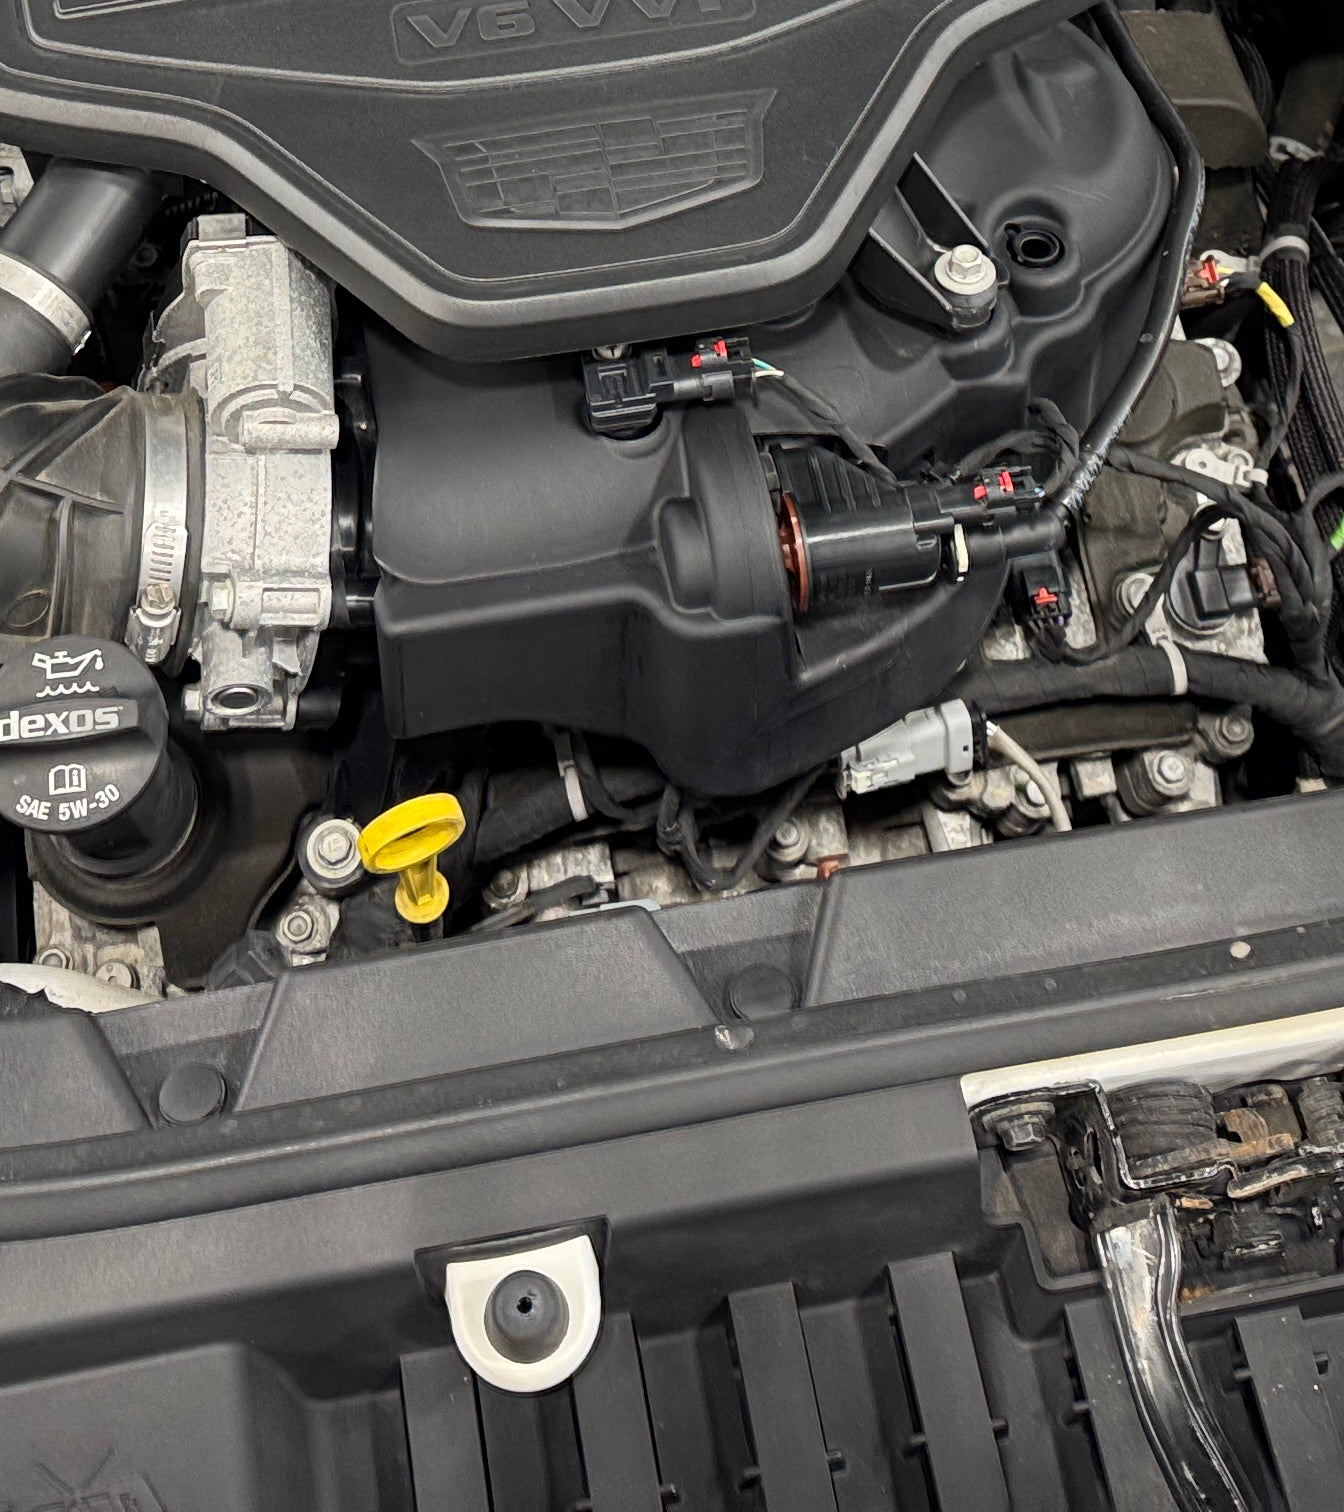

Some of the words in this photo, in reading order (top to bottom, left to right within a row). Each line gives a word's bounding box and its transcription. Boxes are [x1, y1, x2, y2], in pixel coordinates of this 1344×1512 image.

[406, 0, 536, 48] V6
[15, 794, 52, 821] SAE
[58, 784, 121, 821] 5W-30
